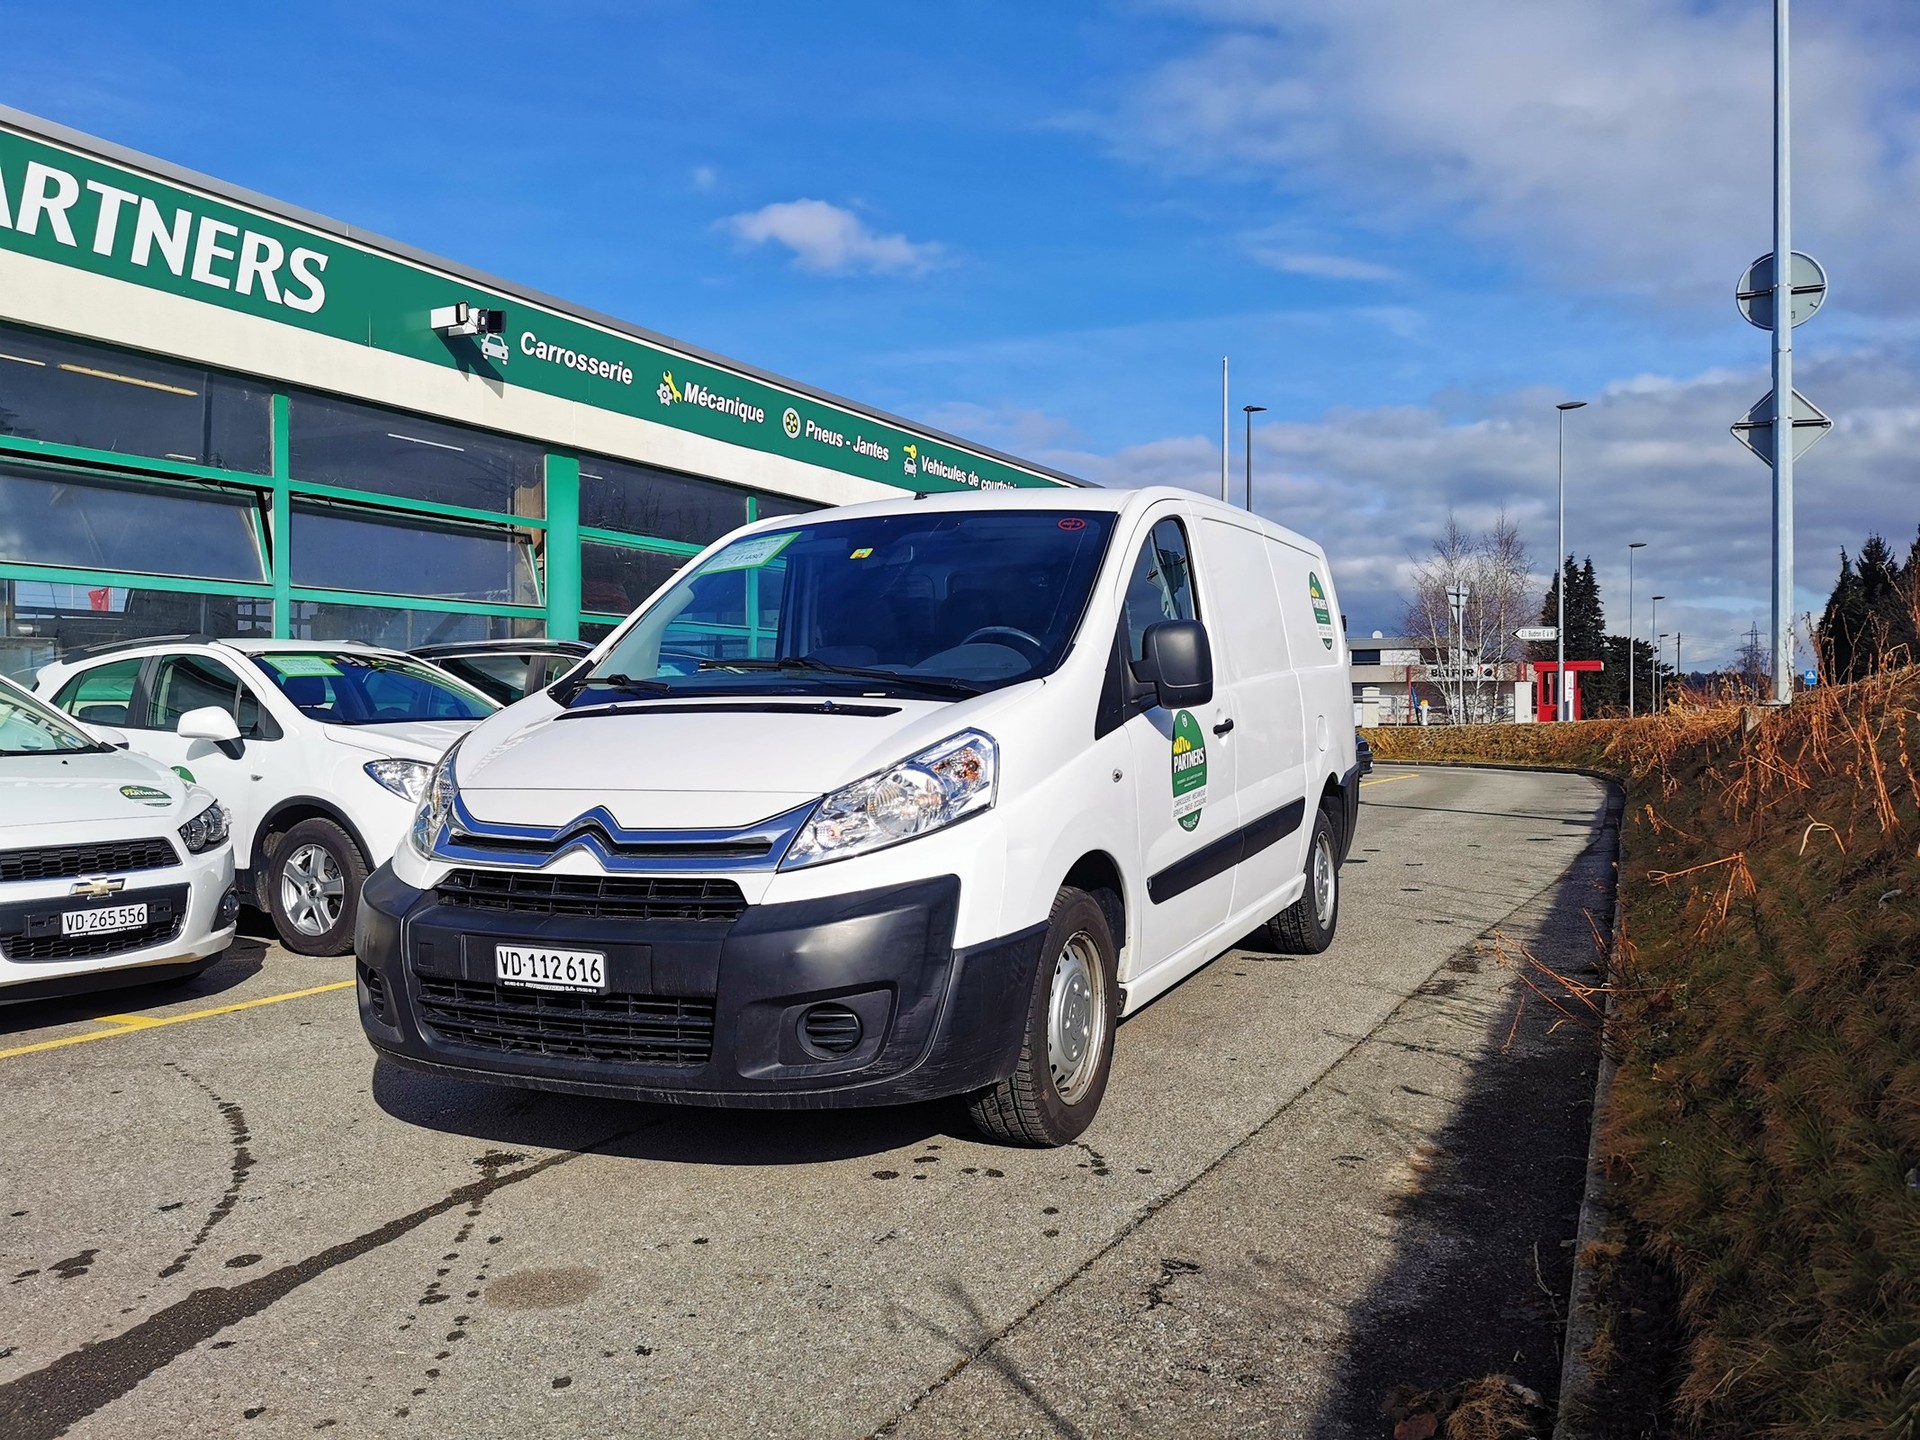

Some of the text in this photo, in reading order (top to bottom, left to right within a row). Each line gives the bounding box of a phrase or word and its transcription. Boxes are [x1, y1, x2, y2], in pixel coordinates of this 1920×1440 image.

[0, 160, 329, 314] RTNERS
[520, 331, 633, 385] Carrosserie
[683, 382, 765, 424] Mécanique
[805, 419, 844, 448] Pneus
[852, 435, 889, 461] Jantes
[921, 455, 967, 483] Vehicules
[967, 471, 979, 487] de
[1173, 747, 1205, 774] PARTNERS
